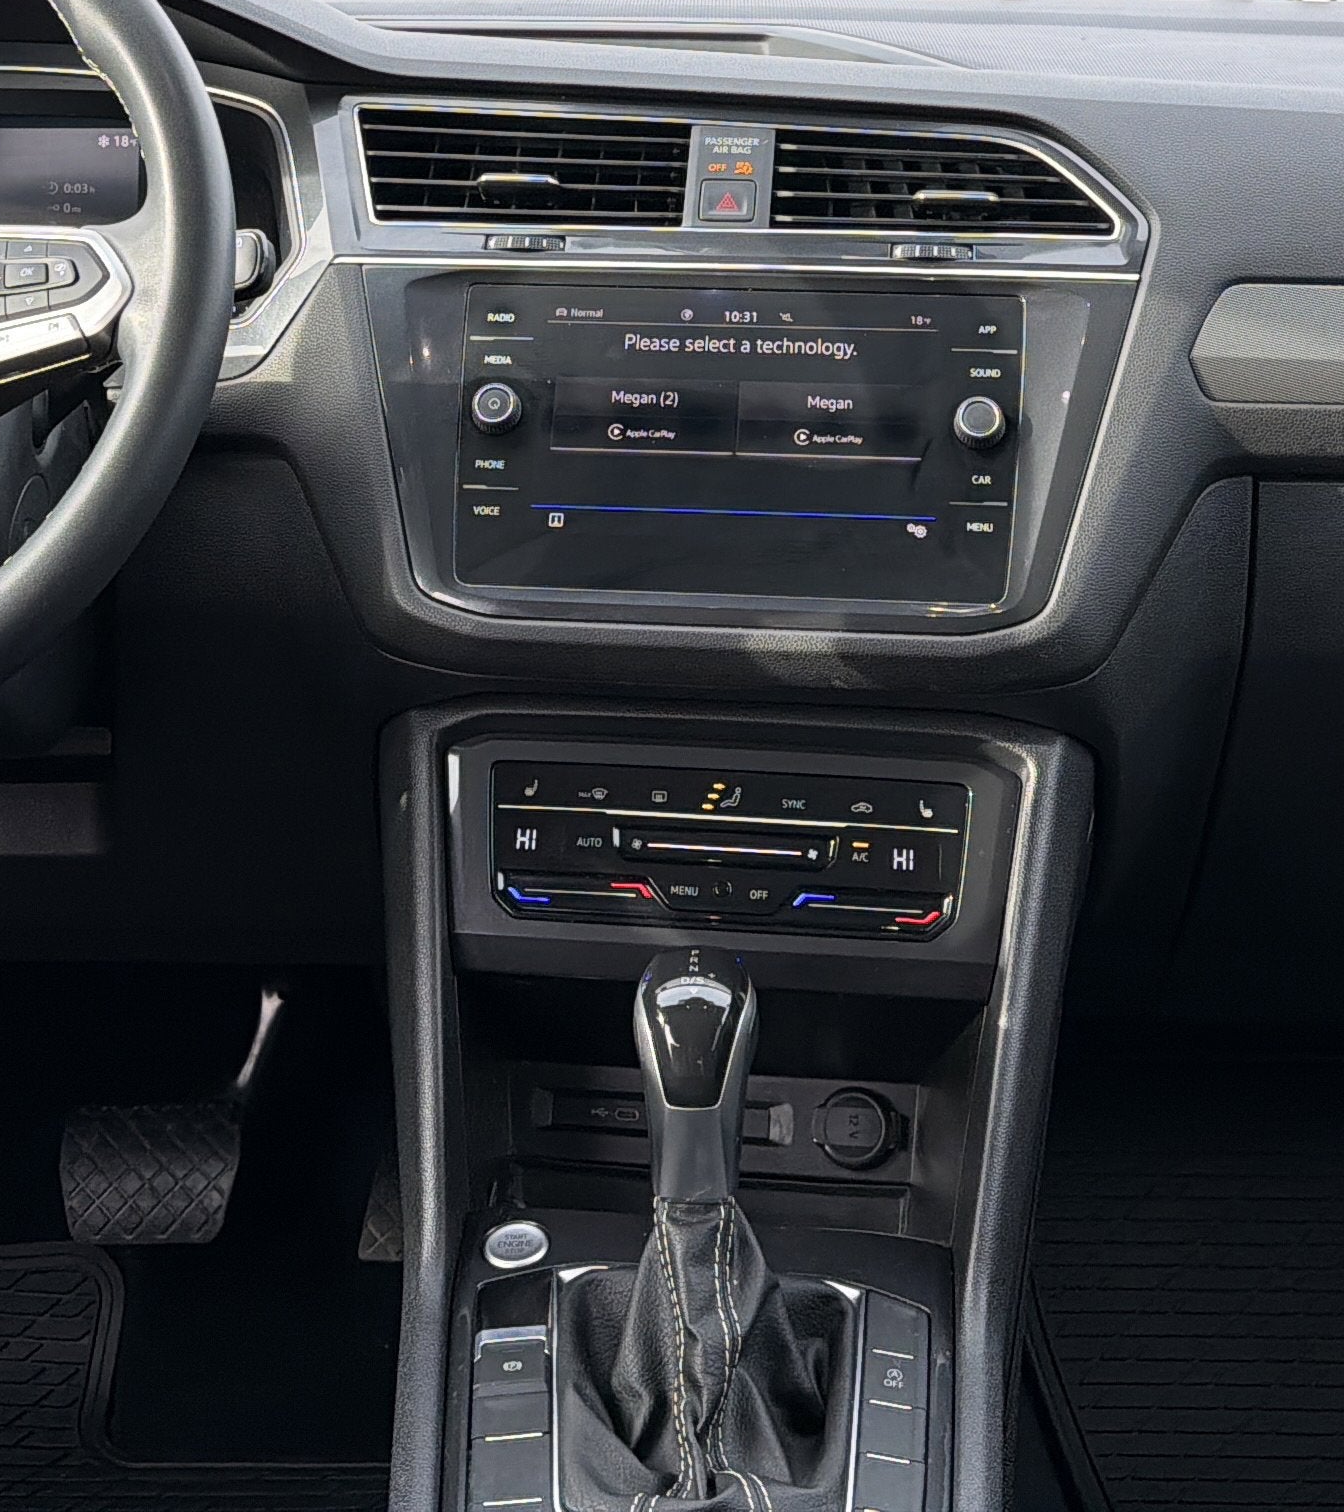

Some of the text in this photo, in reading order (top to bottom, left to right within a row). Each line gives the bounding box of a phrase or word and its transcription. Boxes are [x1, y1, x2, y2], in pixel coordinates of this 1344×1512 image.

[704, 136, 760, 146] PASSENGER
[712, 146, 752, 155] AIR BAG
[708, 163, 728, 172] OFF
[19, 266, 35, 277] OK
[487, 313, 515, 323] RADIO
[570, 307, 604, 318] Normal
[723, 310, 758, 323] 10:31
[978, 325, 997, 335] APP
[624, 333, 858, 360] Please select a technology.
[484, 355, 513, 366] MEDIA
[969, 368, 1001, 378] SOUND
[611, 390, 679, 408] Megan (2)
[807, 395, 853, 413] Megan
[625, 429, 676, 440] Apple CarPlay
[812, 434, 863, 445] Apple CarPlay
[475, 459, 505, 470] PHONE
[971, 475, 992, 485] CAR
[473, 506, 501, 516] VOICE
[966, 522, 994, 533] MENU
[781, 798, 807, 810] SYNC
[515, 828, 538, 851] HI
[576, 836, 603, 848] AUTO
[851, 852, 869, 863] A/C
[892, 847, 915, 871] HI
[669, 885, 699, 897] MENU
[749, 889, 769, 902] OFF
[504, 1233, 528, 1241] START
[497, 1239, 534, 1249] ENGINE
[883, 1378, 904, 1389] OFF
